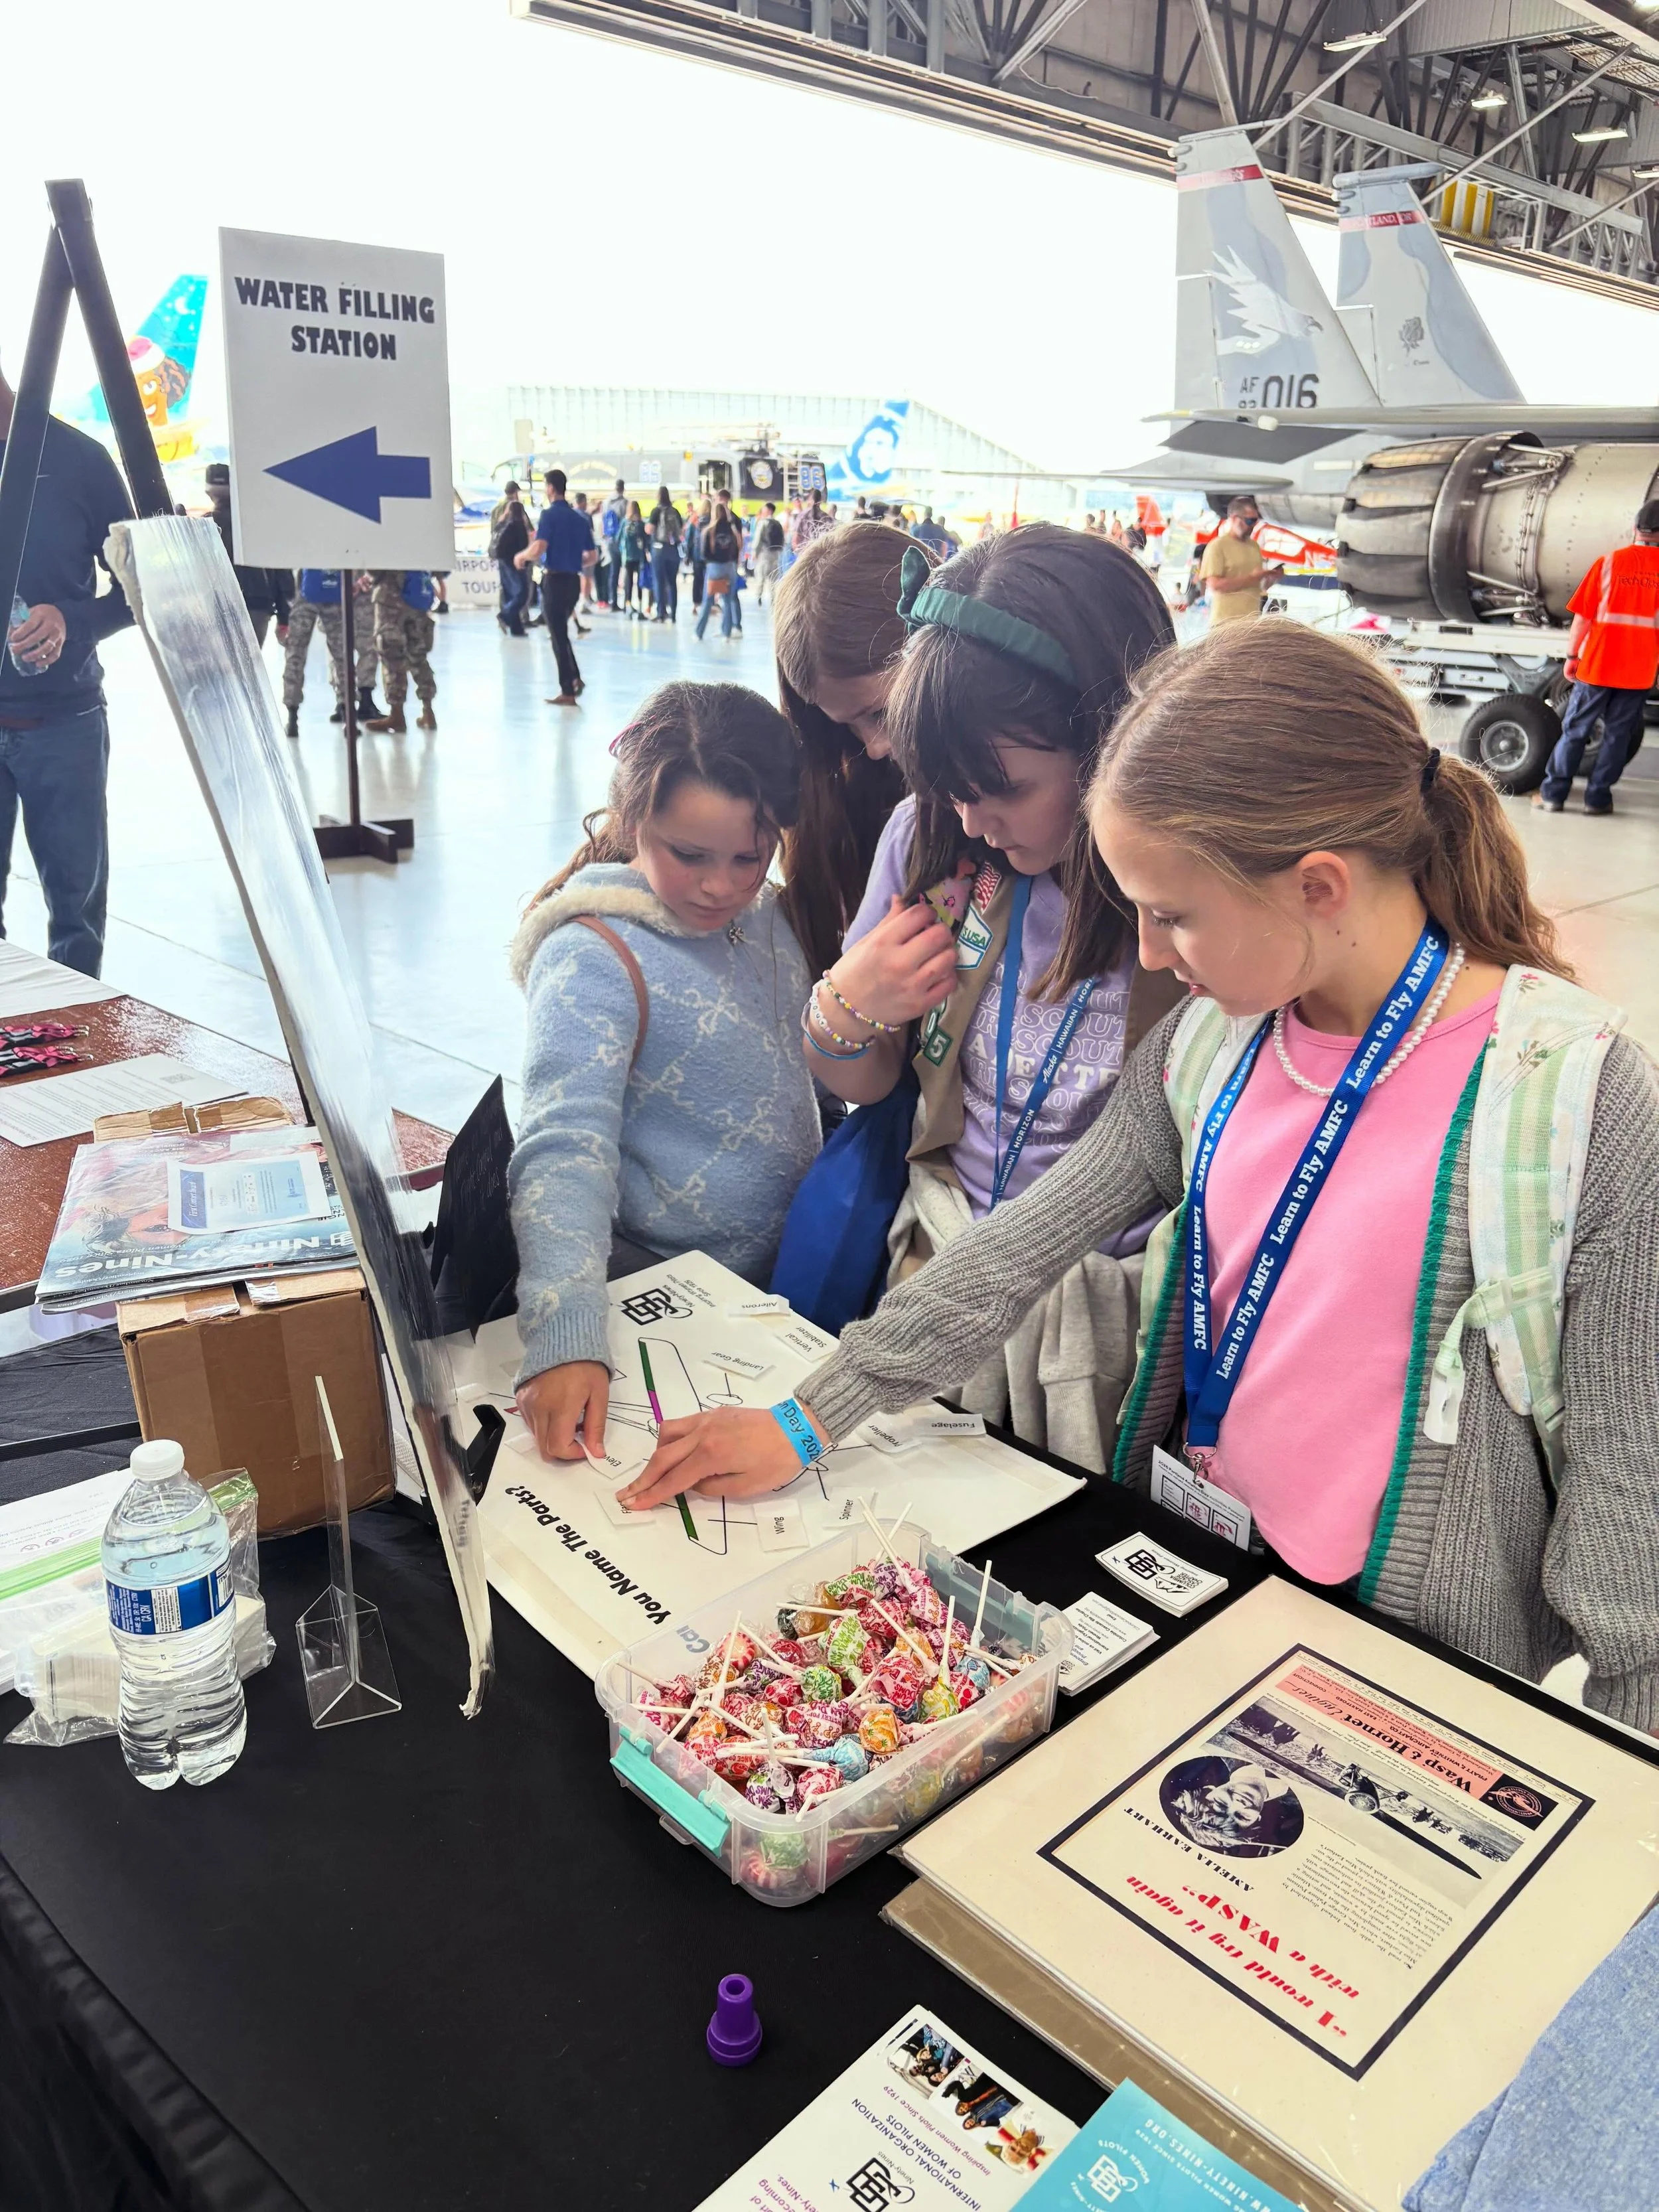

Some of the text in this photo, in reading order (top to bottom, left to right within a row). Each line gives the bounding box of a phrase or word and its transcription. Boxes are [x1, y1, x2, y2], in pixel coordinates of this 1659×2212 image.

[234, 276, 435, 324] WATER FILLING
[291, 327, 397, 360] STATION
[1240, 374, 1319, 409] AF 016
[968, 930, 986, 946] USA
[1346, 936, 1438, 1088] Learn to Fly AMFC
[930, 1034, 946, 1058] 5
[999, 1154, 1015, 1190] HAWAIIAN
[1013, 1108, 1034, 1147] HORIZON
[1043, 1055, 1057, 1083] Alaska
[1056, 1009, 1078, 1048] HAWAIIAN
[1195, 1048, 1254, 1191] Learn to Fly AMFC
[1269, 1100, 1347, 1244] Learn to Fly AMFC
[56, 1237, 317, 1278] Ninety-Nines
[1193, 1254, 1202, 1269] to
[1190, 1272, 1204, 1297] Fly
[740, 1301, 778, 1310] Ailerons
[1216, 1253, 1273, 1378] Learn to Fly AMFC
[795, 1325, 828, 1348] Stabilizer
[1193, 1299, 1206, 1349] AMFC
[785, 1333, 812, 1352] Vertical
[711, 1352, 764, 1370] Landing Gear
[783, 1406, 804, 1432] Day
[505, 1485, 559, 1525] Parts?
[839, 1499, 853, 1520] Spinner
[773, 1516, 784, 1534] Wing
[555, 1524, 587, 1552] The
[585, 1550, 638, 1595] Name
[1169, 1573, 1195, 1588] COLUMBIA
[1177, 1573, 1199, 1586] CASCADE
[1180, 1572, 1202, 1584] CHAPTER
[140, 1612, 151, 1622] CA
[633, 1592, 670, 1624] You
[1075, 1607, 1089, 1617] Chapter
[825, 1629, 836, 1645] APPLE
[1088, 1629, 1101, 1640] Women
[1094, 1620, 1110, 1631] Cascade
[1110, 1629, 1127, 1642] Columbia
[1086, 1635, 1109, 1651] International
[1293, 1672, 1327, 1692] CONNECTICUT
[1285, 1680, 1342, 1715] Engines
[1335, 1696, 1363, 1712] HARTFORD
[1363, 1711, 1377, 1720] EAST
[1344, 1714, 1409, 1755] Hornet
[1397, 1731, 1430, 1749] AIRCRAFT
[1429, 1749, 1460, 1767] WHITNEY
[1425, 1759, 1471, 1793] Wasp
[1465, 1768, 1487, 1781] PRATT
[1123, 1808, 1254, 1891] AMELIA EARHART
[1127, 1876, 1183, 1915] again
[1185, 1919, 1205, 1933] it
[1208, 1933, 1243, 1958] try
[1289, 1951, 1305, 1961] a
[1244, 1961, 1313, 2006] would
[1309, 1964, 1358, 1998] with
[883, 2086, 990, 2175] Inspiring Women Pilots Since 1929
[851, 2099, 980, 2211] INTERNATIONAL ORGANIZATION
[885, 2114, 961, 2179] OF WOMEN PILOTS
[877, 2151, 914, 2184] Ninety-Nines
[1098, 2140, 1150, 2185] WOMEN PILOTS
